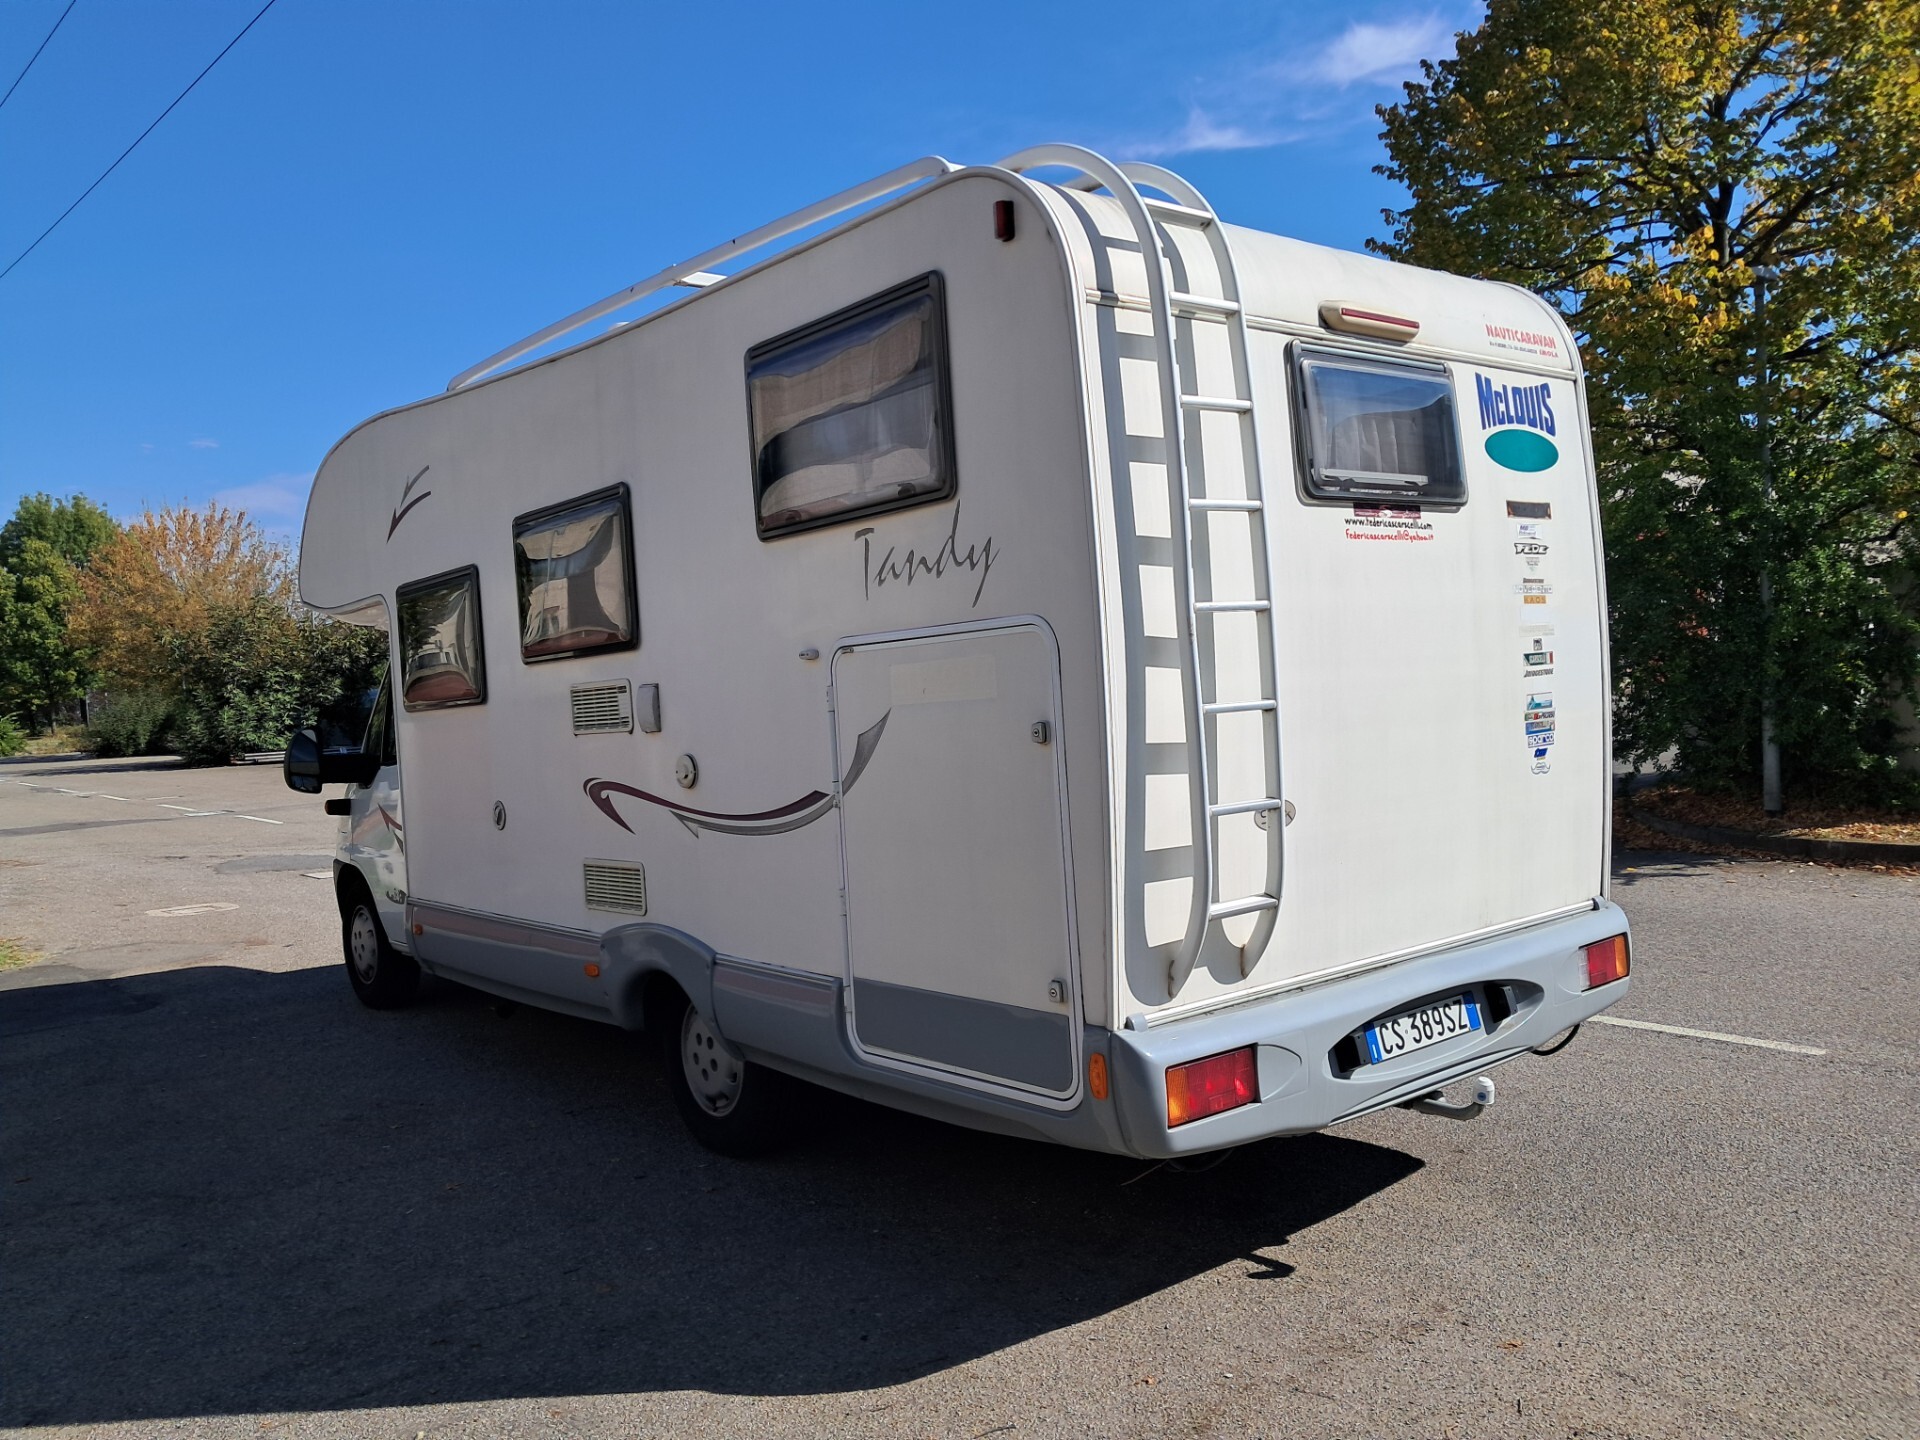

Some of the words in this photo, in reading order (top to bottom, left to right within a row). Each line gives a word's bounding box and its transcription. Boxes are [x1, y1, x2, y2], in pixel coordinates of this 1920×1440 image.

[1485, 323, 1557, 349] NAUTICARAVAN
[854, 498, 1001, 608] Tandy
[1379, 1018, 1405, 1054] CS
[1407, 999, 1468, 1044] 389SZ
